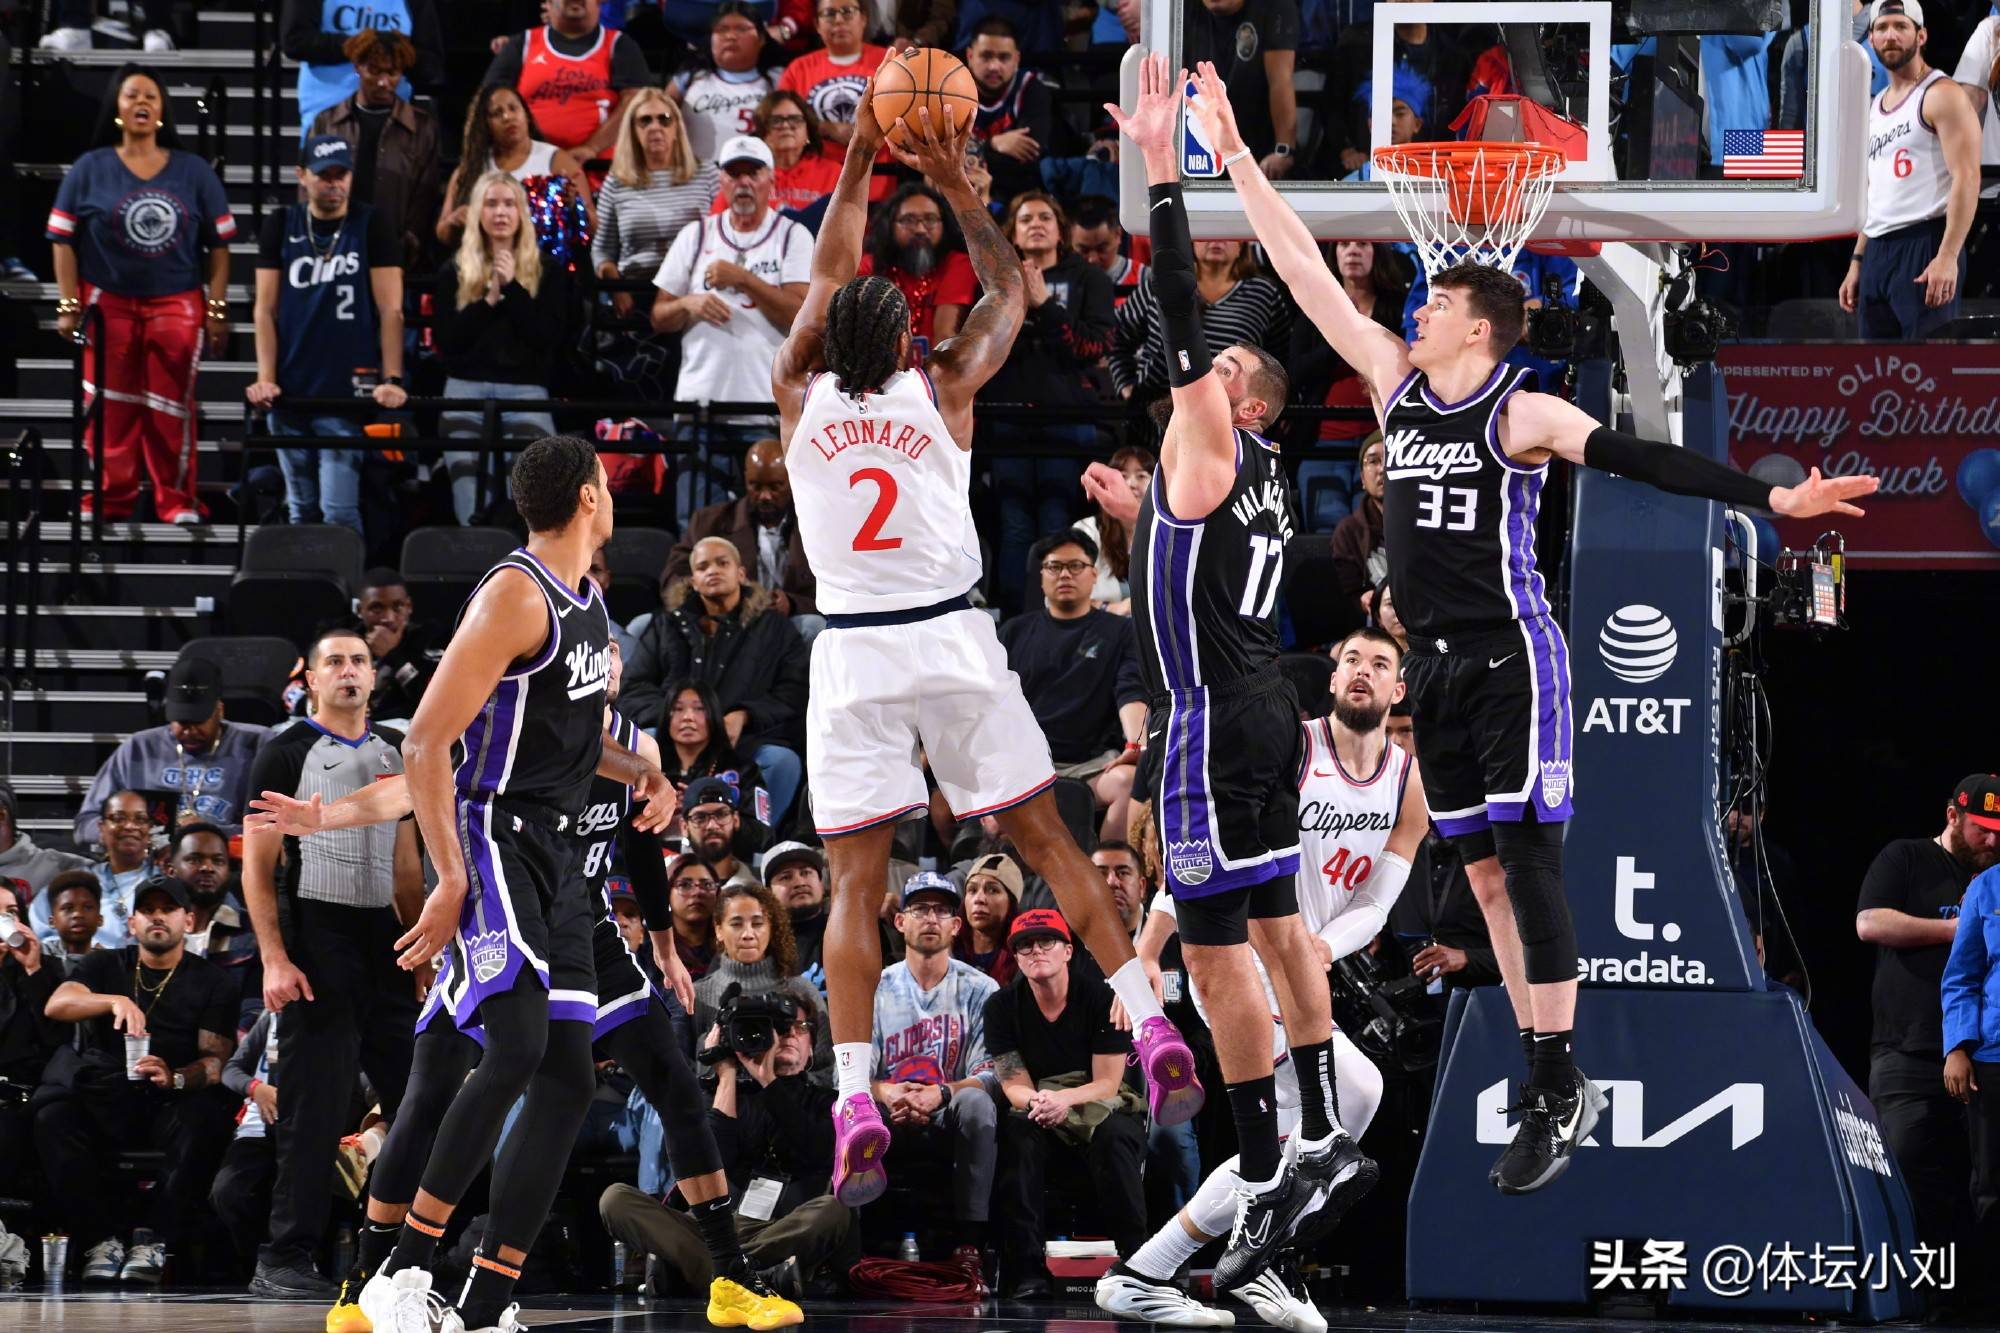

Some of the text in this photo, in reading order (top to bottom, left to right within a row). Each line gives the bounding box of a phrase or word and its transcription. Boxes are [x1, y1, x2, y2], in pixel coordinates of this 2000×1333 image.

[333, 6, 401, 31] Clips
[693, 93, 764, 113] Clipper
[736, 108, 757, 133] 5
[1869, 120, 1911, 160] ippers
[1188, 154, 1209, 170] NBA
[1894, 148, 1912, 178] 6
[336, 285, 355, 320] 2
[1723, 355, 1936, 396] PRESENTED BY OLIPOP
[1727, 392, 1850, 448] Happy
[811, 419, 932, 462] LEONARD
[1385, 429, 1483, 480] Kings
[849, 467, 904, 552] 2
[1416, 483, 1478, 531] 33
[1239, 532, 1284, 620] 17
[565, 641, 610, 701] King
[1582, 697, 1692, 735] AT&T
[1299, 801, 1392, 839] Clippers
[583, 842, 607, 878] 8
[1174, 857, 1211, 870] KINGS
[1322, 847, 1372, 891] 40
[472, 949, 506, 967] KINGS
[1576, 951, 1715, 985] eradata.
